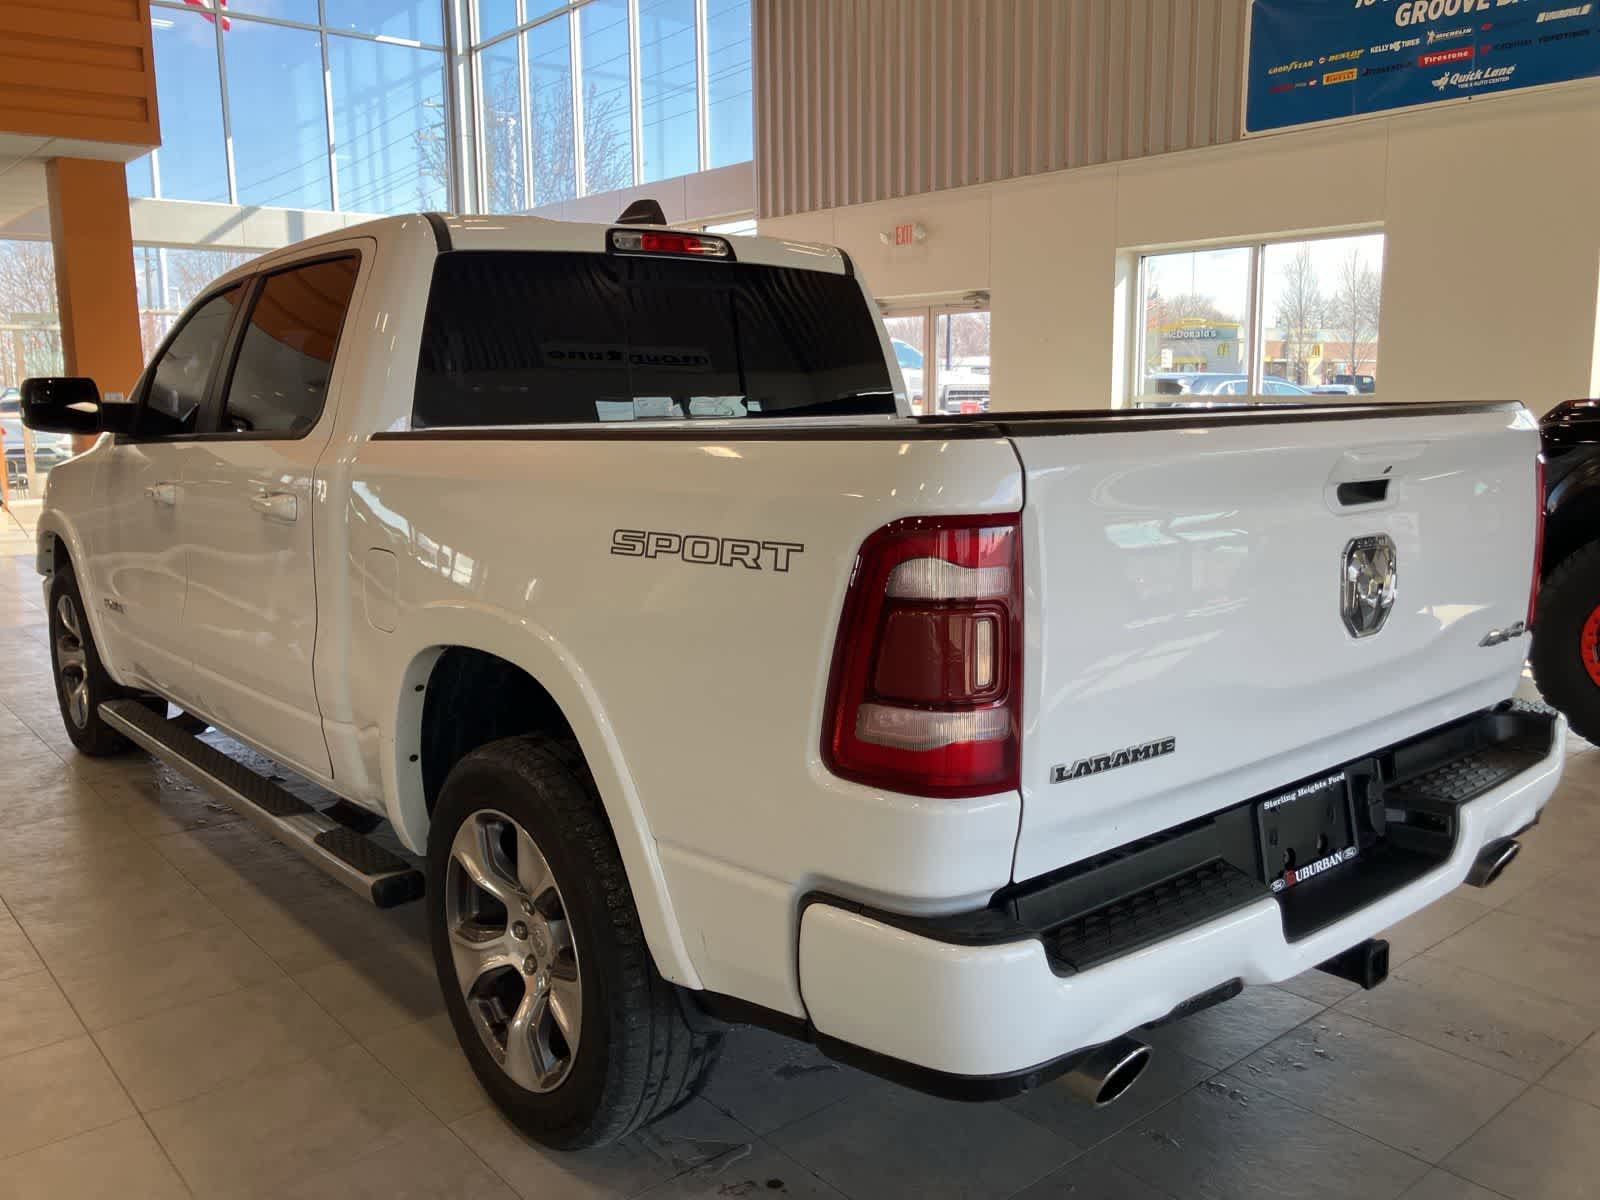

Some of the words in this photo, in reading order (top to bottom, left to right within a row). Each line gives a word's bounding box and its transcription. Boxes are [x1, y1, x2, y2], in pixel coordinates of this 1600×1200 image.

[1268, 60, 1314, 75] GOODYEAR
[1424, 51, 1469, 65] Firestone
[1449, 69, 1483, 85] Quick
[1483, 64, 1516, 79] Lane
[611, 528, 805, 573] SPORT
[1050, 736, 1176, 784] LARAMIE
[1263, 791, 1297, 810] Sterling
[1298, 780, 1327, 798] Heights
[1328, 772, 1345, 785] Ford
